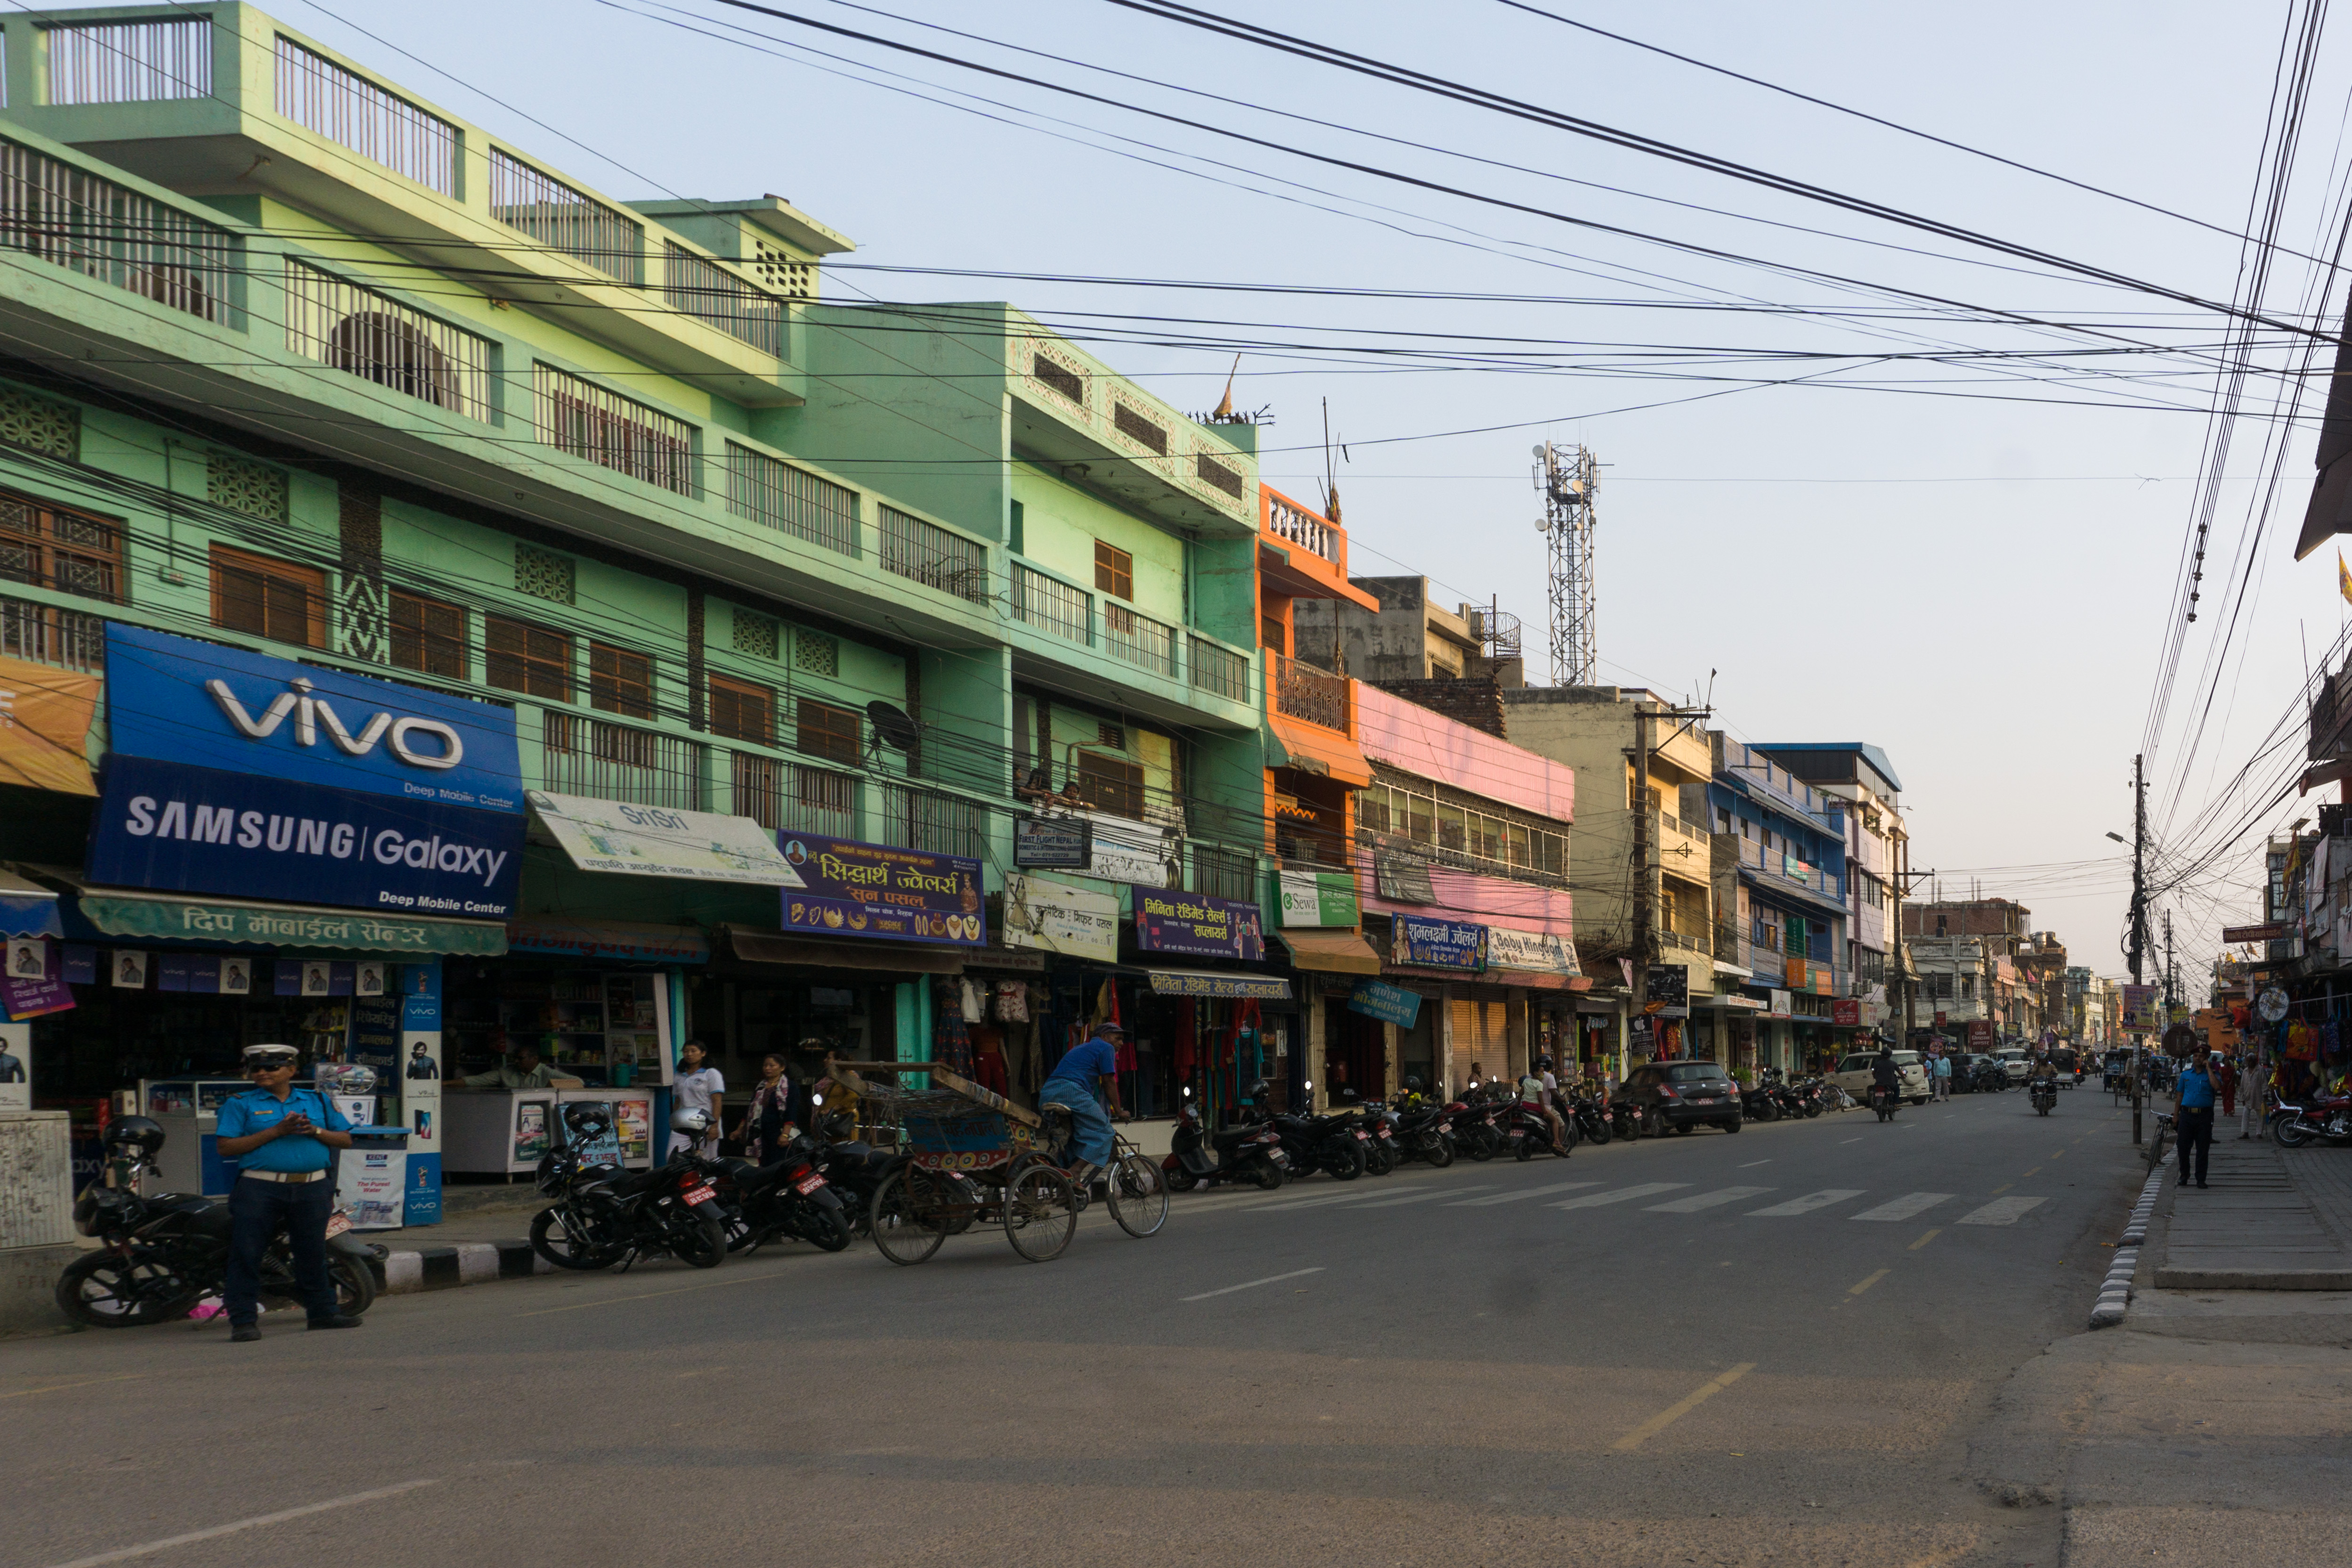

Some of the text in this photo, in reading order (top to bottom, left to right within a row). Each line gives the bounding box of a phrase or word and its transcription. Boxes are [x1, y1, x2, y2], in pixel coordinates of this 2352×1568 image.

[206, 678, 463, 769] vivo
[405, 782, 513, 808] Deep Mobile Center
[127, 796, 507, 886] SAMSUNG Galaxy
[1019, 834, 1035, 843] FIRST
[1036, 835, 1055, 844] FLIGHT
[1056, 836, 1073, 844] NEPAL
[584, 859, 625, 870] पशुपति
[820, 853, 959, 894] सिद्धार्थ ज्वेलर्स
[380, 891, 506, 913] Deep Mobile Center
[850, 888, 925, 907] सुन पसल
[1283, 893, 1316, 910] eSewa
[184, 907, 235, 932] दिप
[1145, 898, 1175, 917] मिनिता
[1176, 903, 1204, 920] रेडिमेड
[1096, 918, 1113, 930] पसल
[1193, 925, 1227, 940] सप्लायर्स
[1409, 923, 1477, 947] शुभलक्ष्मी ज्वेलर्स
[1495, 932, 1565, 959] Baby Kingdom
[1152, 975, 1183, 991] मिनिता
[1184, 977, 1212, 992] रेडिमेड
[1246, 982, 1283, 995] सप्लायर्स
[1370, 986, 1402, 1003] गणेश
[409, 1007, 436, 1015] vivo
[1353, 990, 1412, 1018] भोजनालय
[409, 1202, 437, 1210] vivo
